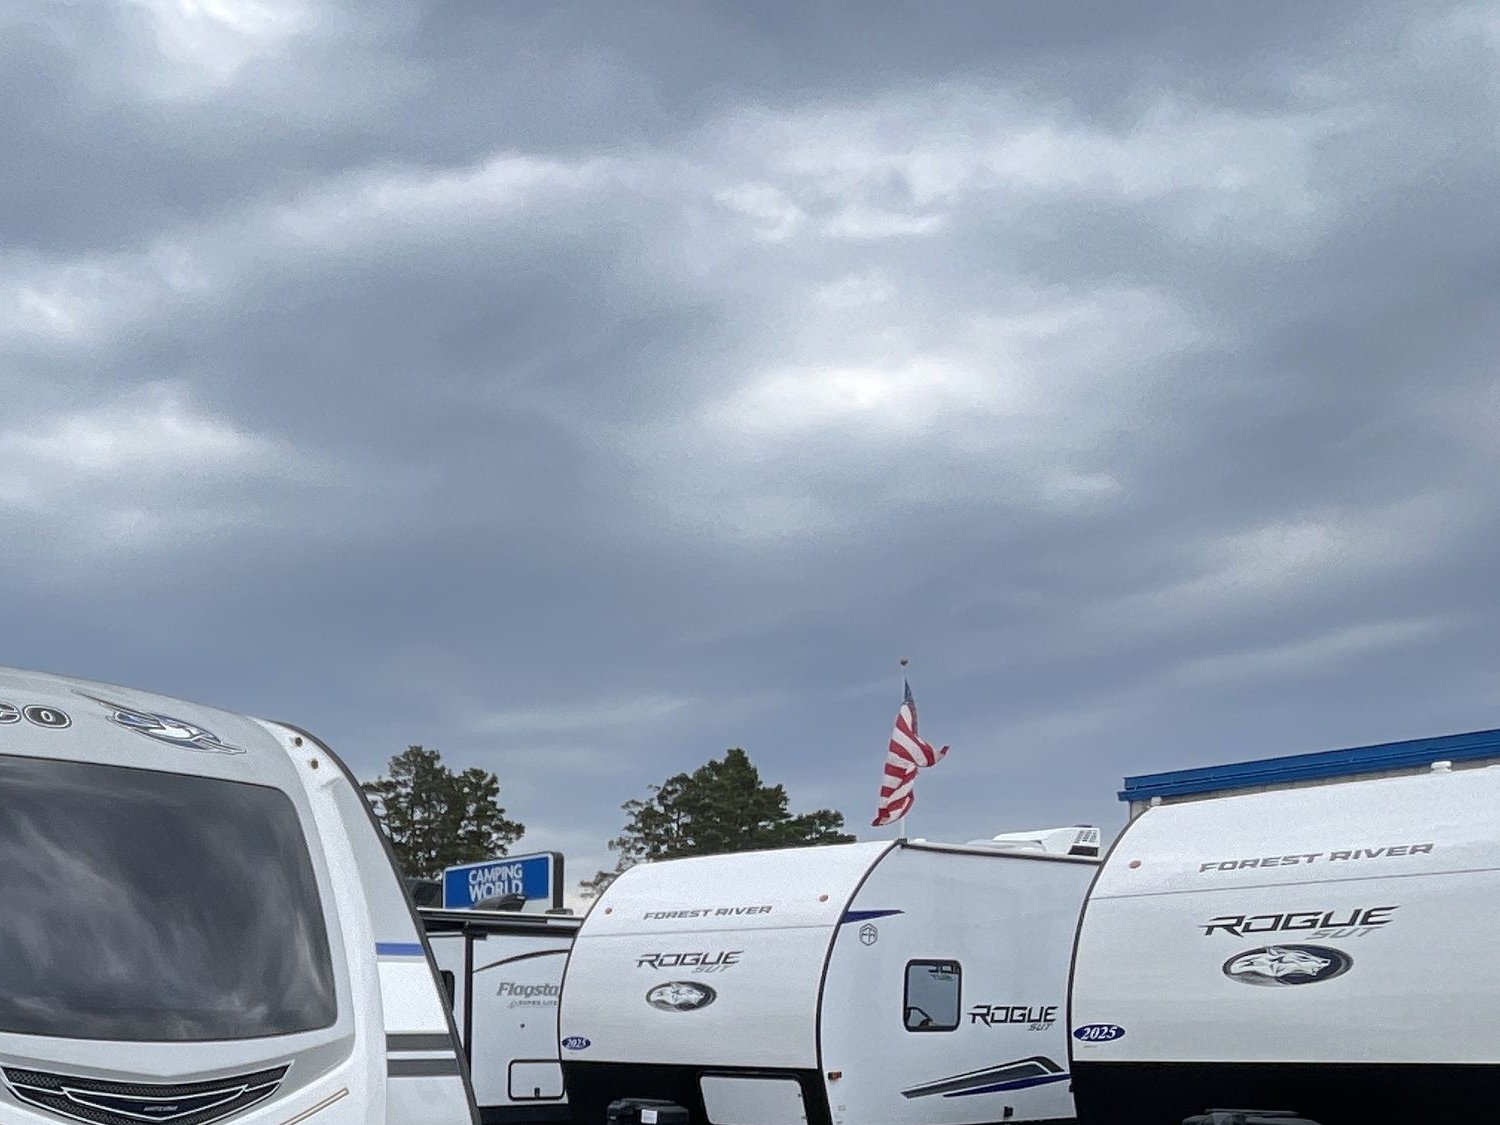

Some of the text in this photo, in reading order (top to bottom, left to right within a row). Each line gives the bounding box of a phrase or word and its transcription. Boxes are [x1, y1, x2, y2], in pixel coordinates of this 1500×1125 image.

[1199, 843, 1434, 873] FOREST RIVER
[468, 863, 523, 885] CAMPING
[468, 879, 523, 902] WORLD
[643, 905, 772, 920] FOREST RIVER
[1198, 905, 1401, 938] ROGUE
[1304, 926, 1384, 941] SUT
[635, 950, 744, 971] ROGUE
[691, 965, 734, 974] SUT
[496, 982, 560, 998] Flagsta
[967, 1005, 1058, 1028] ROGUE
[1028, 1023, 1053, 1031] SUT
[1080, 1026, 1118, 1040] 2025
